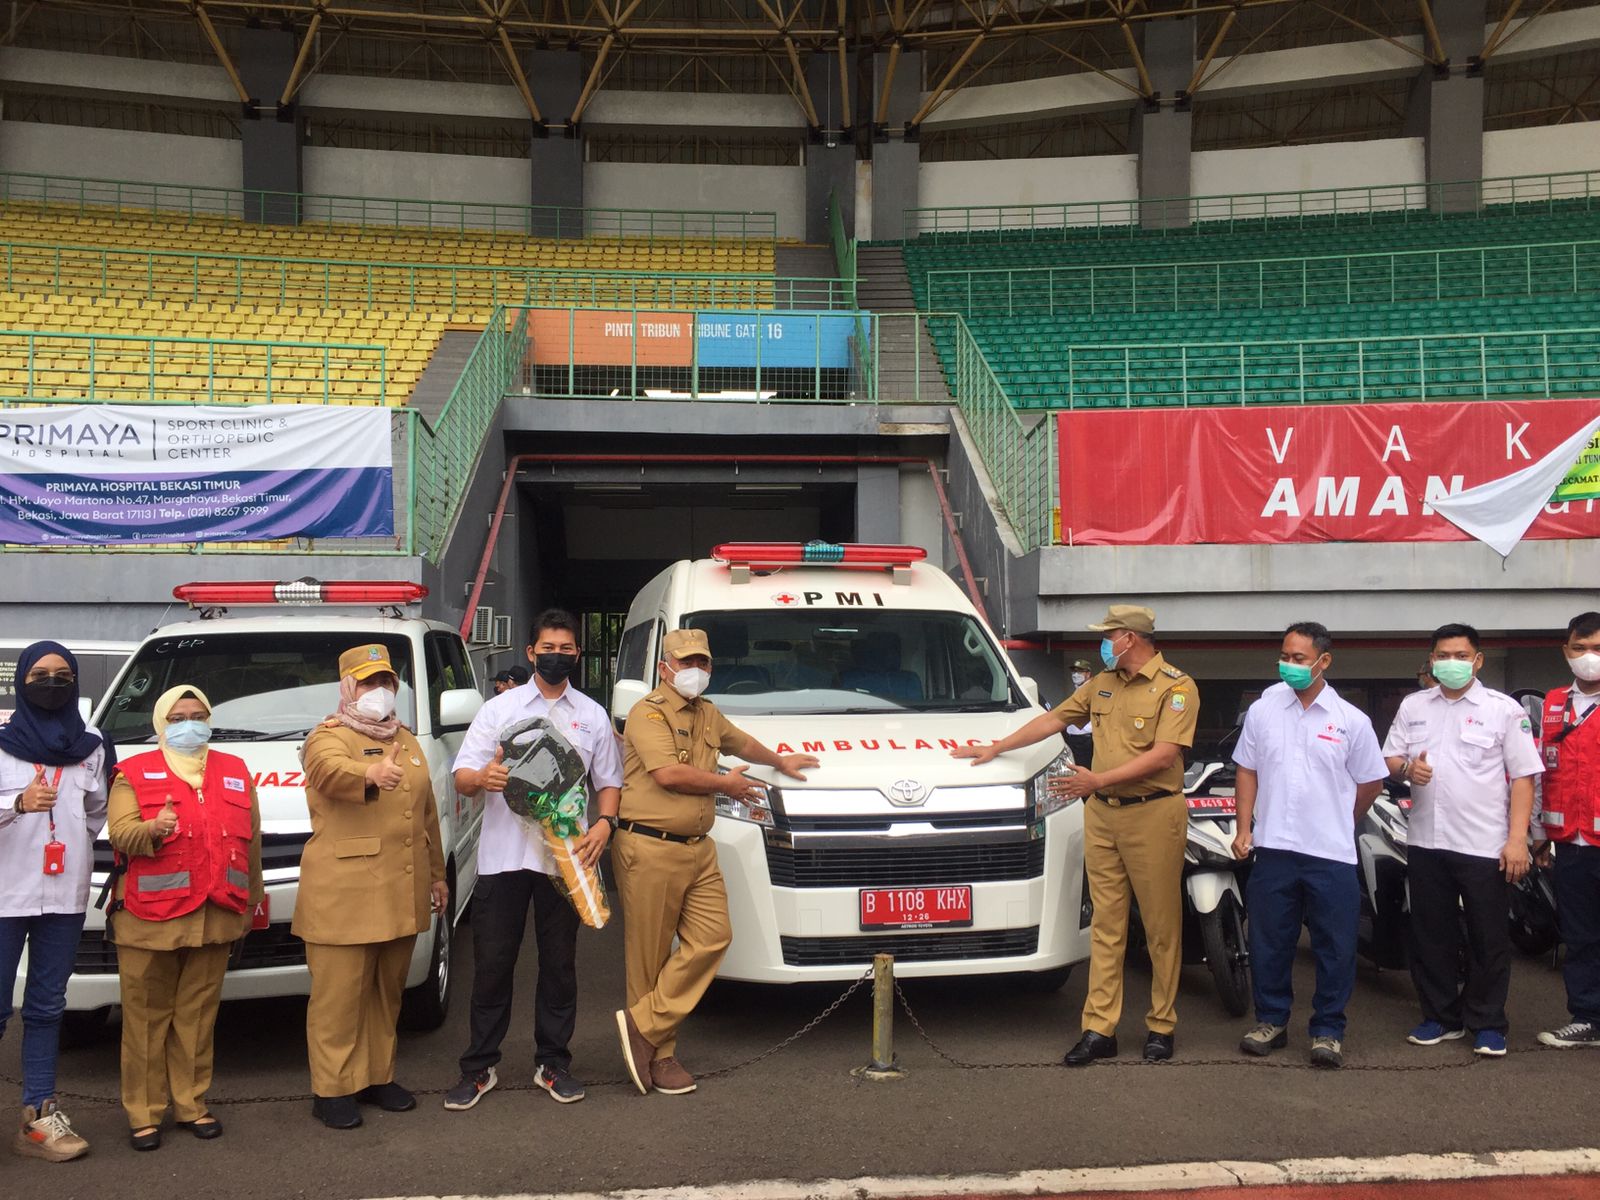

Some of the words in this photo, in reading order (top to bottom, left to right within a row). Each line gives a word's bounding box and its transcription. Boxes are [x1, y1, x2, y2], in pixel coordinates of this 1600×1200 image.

[641, 323, 681, 338] TRIBUN
[688, 323, 731, 338] TIBUNE
[735, 323, 763, 338] GAT
[768, 323, 783, 339] 16
[168, 420, 216, 431] SPORT
[221, 418, 273, 430] CLINIC
[278, 418, 288, 429] &
[0, 423, 141, 445] PRIMAYA
[168, 432, 274, 445] ORTHOPEDIC
[12, 449, 125, 458] HOSPITAL
[168, 447, 232, 460] CENTER
[46, 482, 98, 492] PRIMAYA
[101, 482, 158, 492] HOSPITAL
[161, 481, 201, 491] BEKASI
[203, 480, 241, 490] TIMUR
[9, 496, 31, 505] HM.
[33, 496, 61, 507] Joyo
[65, 496, 113, 505] Martono
[116, 495, 150, 506] No.47,
[154, 494, 220, 506] Margahayu,
[222, 493, 257, 503] Bekasi
[1261, 475, 1464, 518] AMAN
[18, 510, 57, 521] Bekasi,
[59, 510, 89, 520] Jawa
[93, 510, 124, 520] Barat
[159, 508, 185, 520] Telp.
[187, 507, 212, 518] (021)
[214, 507, 239, 517] 8267
[242, 505, 269, 516] 9999
[804, 592, 884, 606] PMI
[866, 893, 876, 912] B
[888, 891, 925, 912] 1108
[937, 889, 967, 910] KHX
